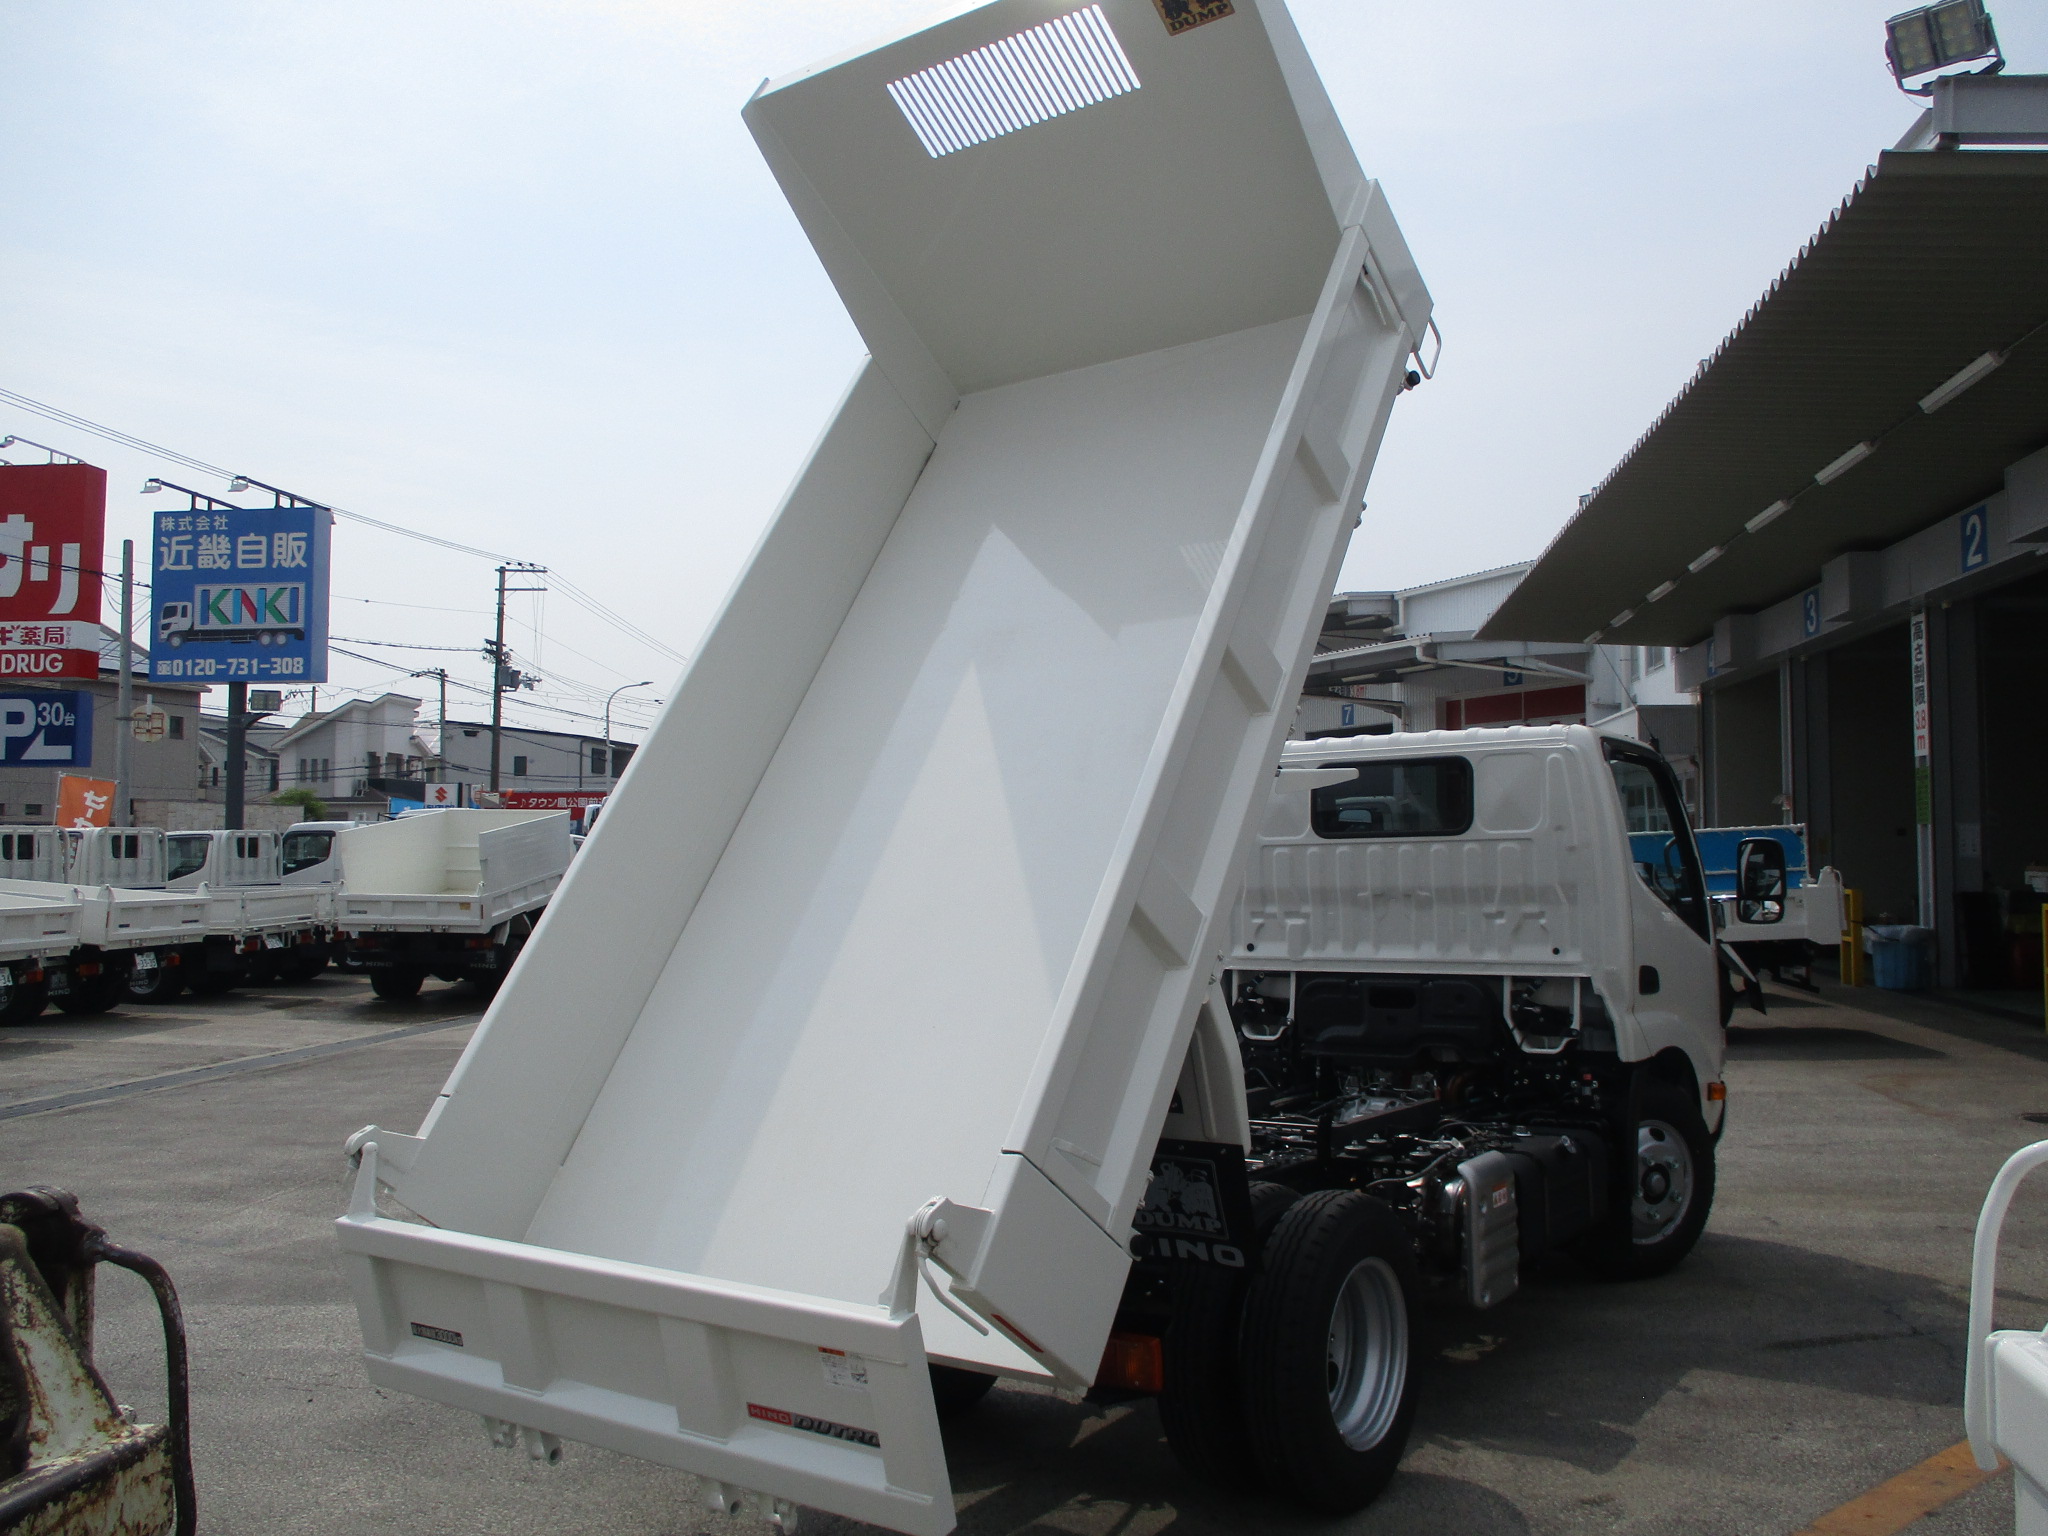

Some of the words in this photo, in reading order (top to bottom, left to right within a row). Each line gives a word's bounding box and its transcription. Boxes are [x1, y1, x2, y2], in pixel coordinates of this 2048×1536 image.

[1169, 2, 1229, 31] DUMP
[160, 515, 229, 531] 株式会社
[159, 532, 308, 571] 近畿自販
[1966, 514, 1982, 567] 2
[1807, 594, 1816, 632] 3
[1, 653, 63, 673] DRUG
[172, 657, 304, 676] 0120-731-308
[37, 702, 75, 726] 30台
[1344, 706, 1352, 723] 7
[0, 699, 36, 759] P
[1136, 1211, 1222, 1233] DUMP
[1150, 1238, 1245, 1267] INO
[750, 1406, 789, 1423] HINO
[795, 1414, 880, 1447] DUTRO
